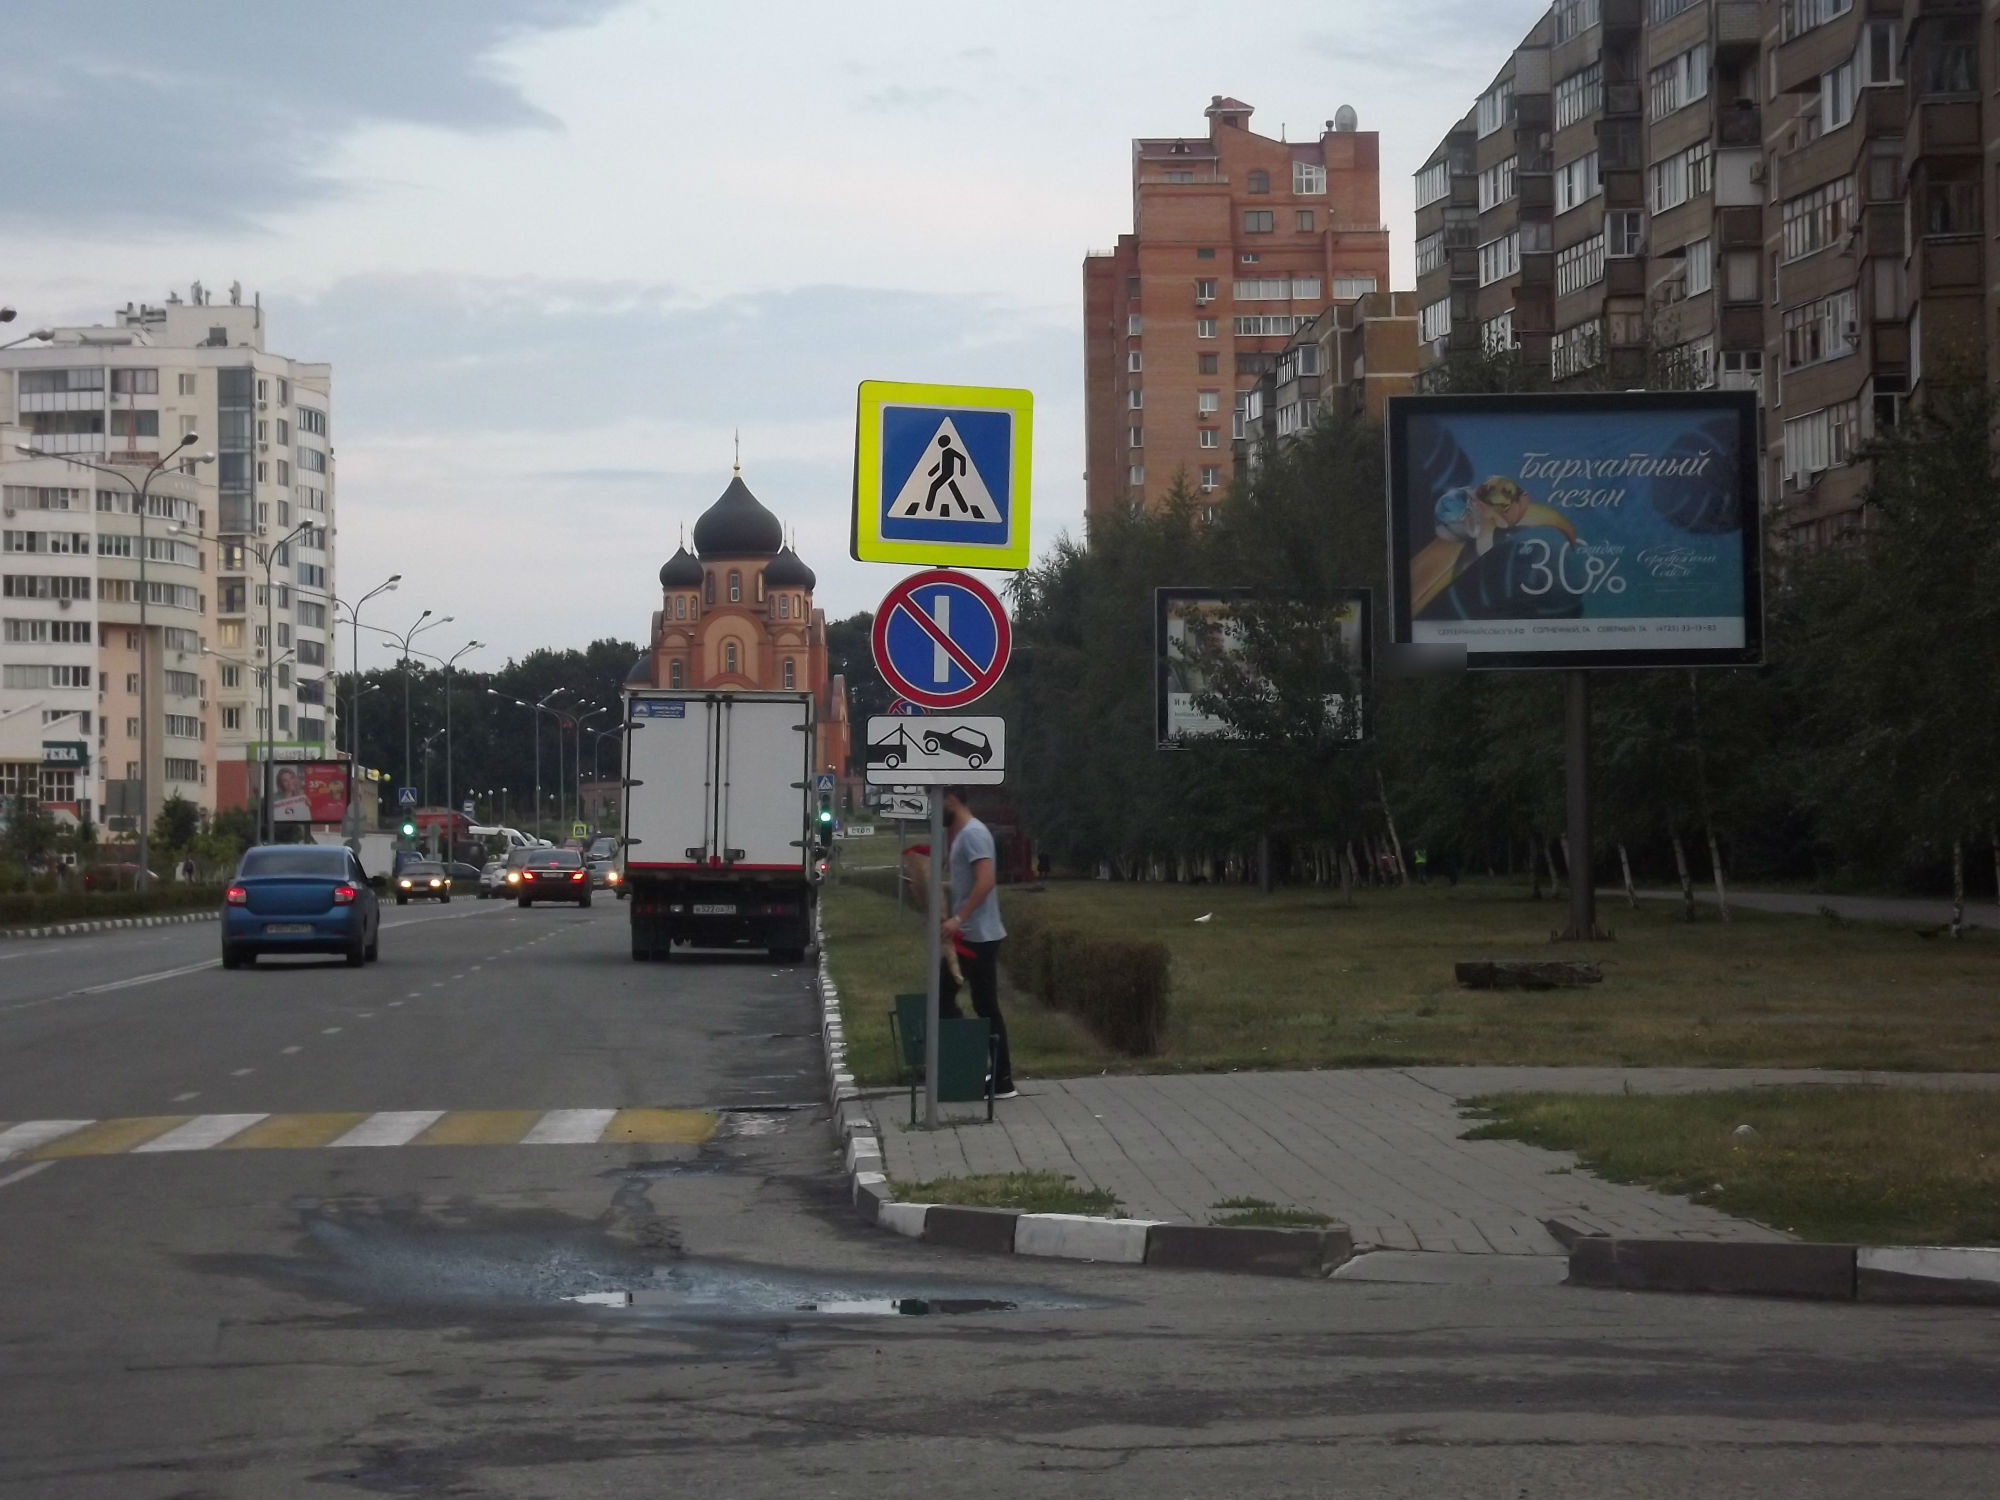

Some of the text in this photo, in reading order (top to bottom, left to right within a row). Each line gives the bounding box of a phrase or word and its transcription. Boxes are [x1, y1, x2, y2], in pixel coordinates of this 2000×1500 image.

[1520, 448, 1712, 488] Бархатный
[1547, 487, 1625, 508] сезон
[1520, 538, 1627, 596] 30%
